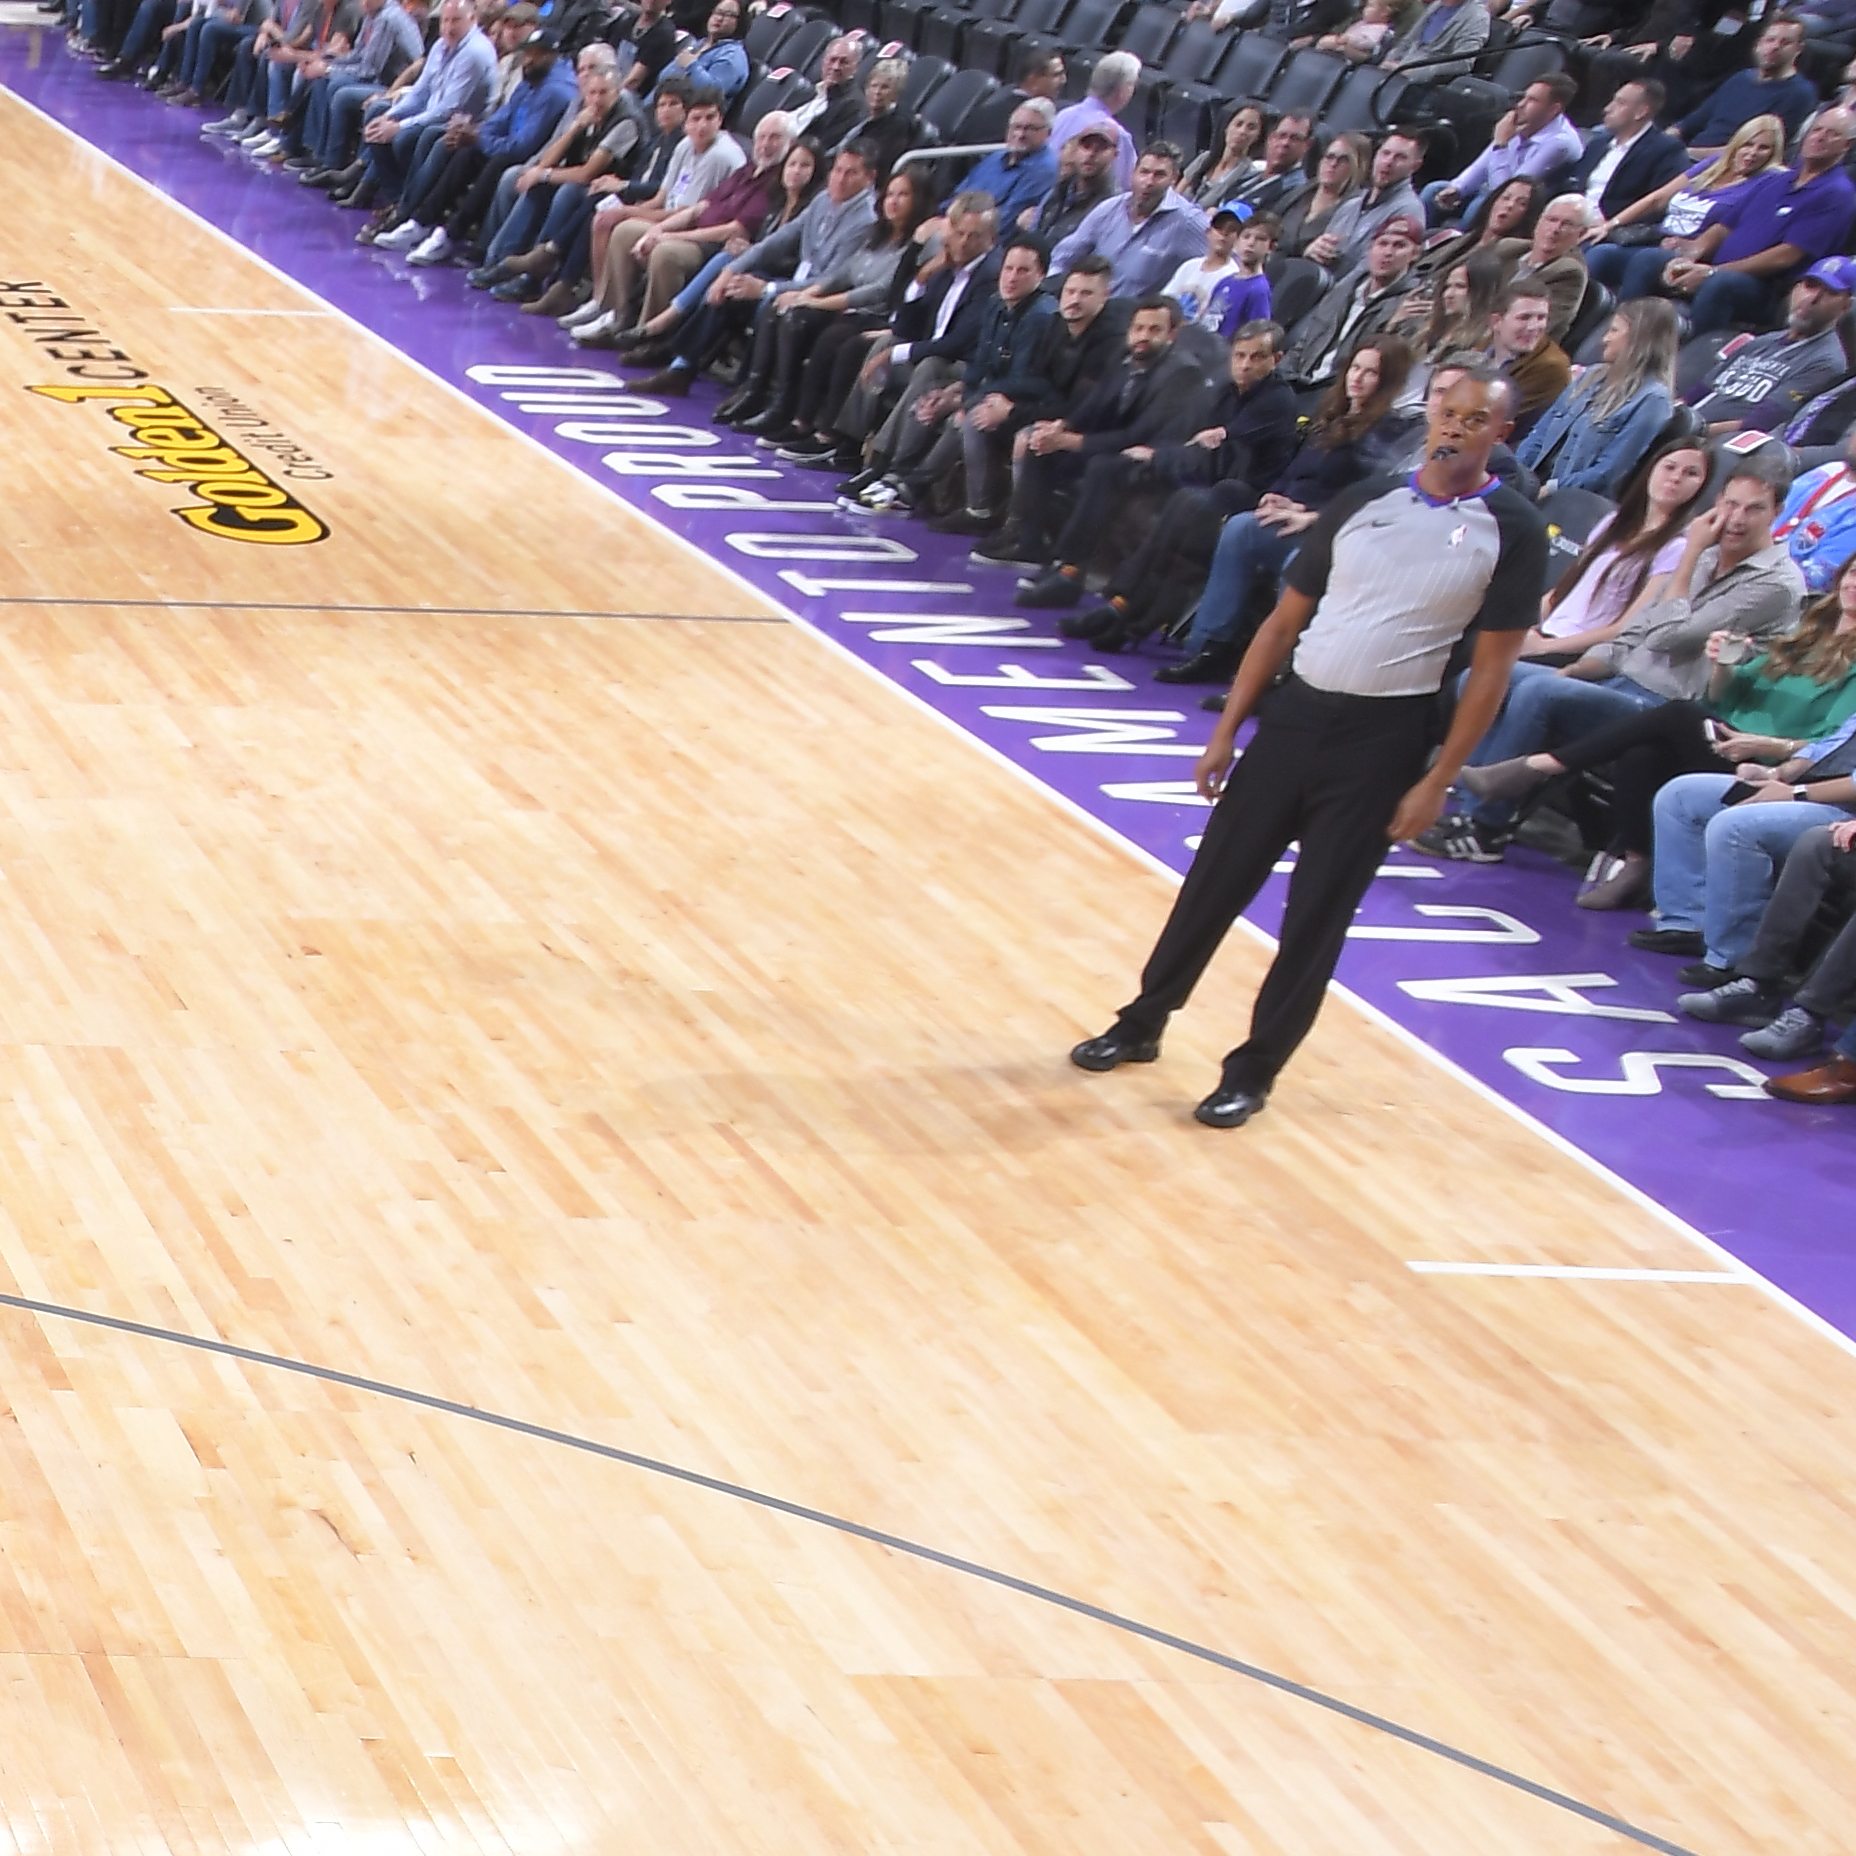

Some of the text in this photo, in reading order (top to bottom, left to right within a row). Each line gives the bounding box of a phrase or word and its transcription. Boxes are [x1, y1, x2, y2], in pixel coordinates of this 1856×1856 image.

[23, 384, 174, 408] 1
[465, 364, 844, 513] PROUD
[104, 403, 332, 545] Golden
